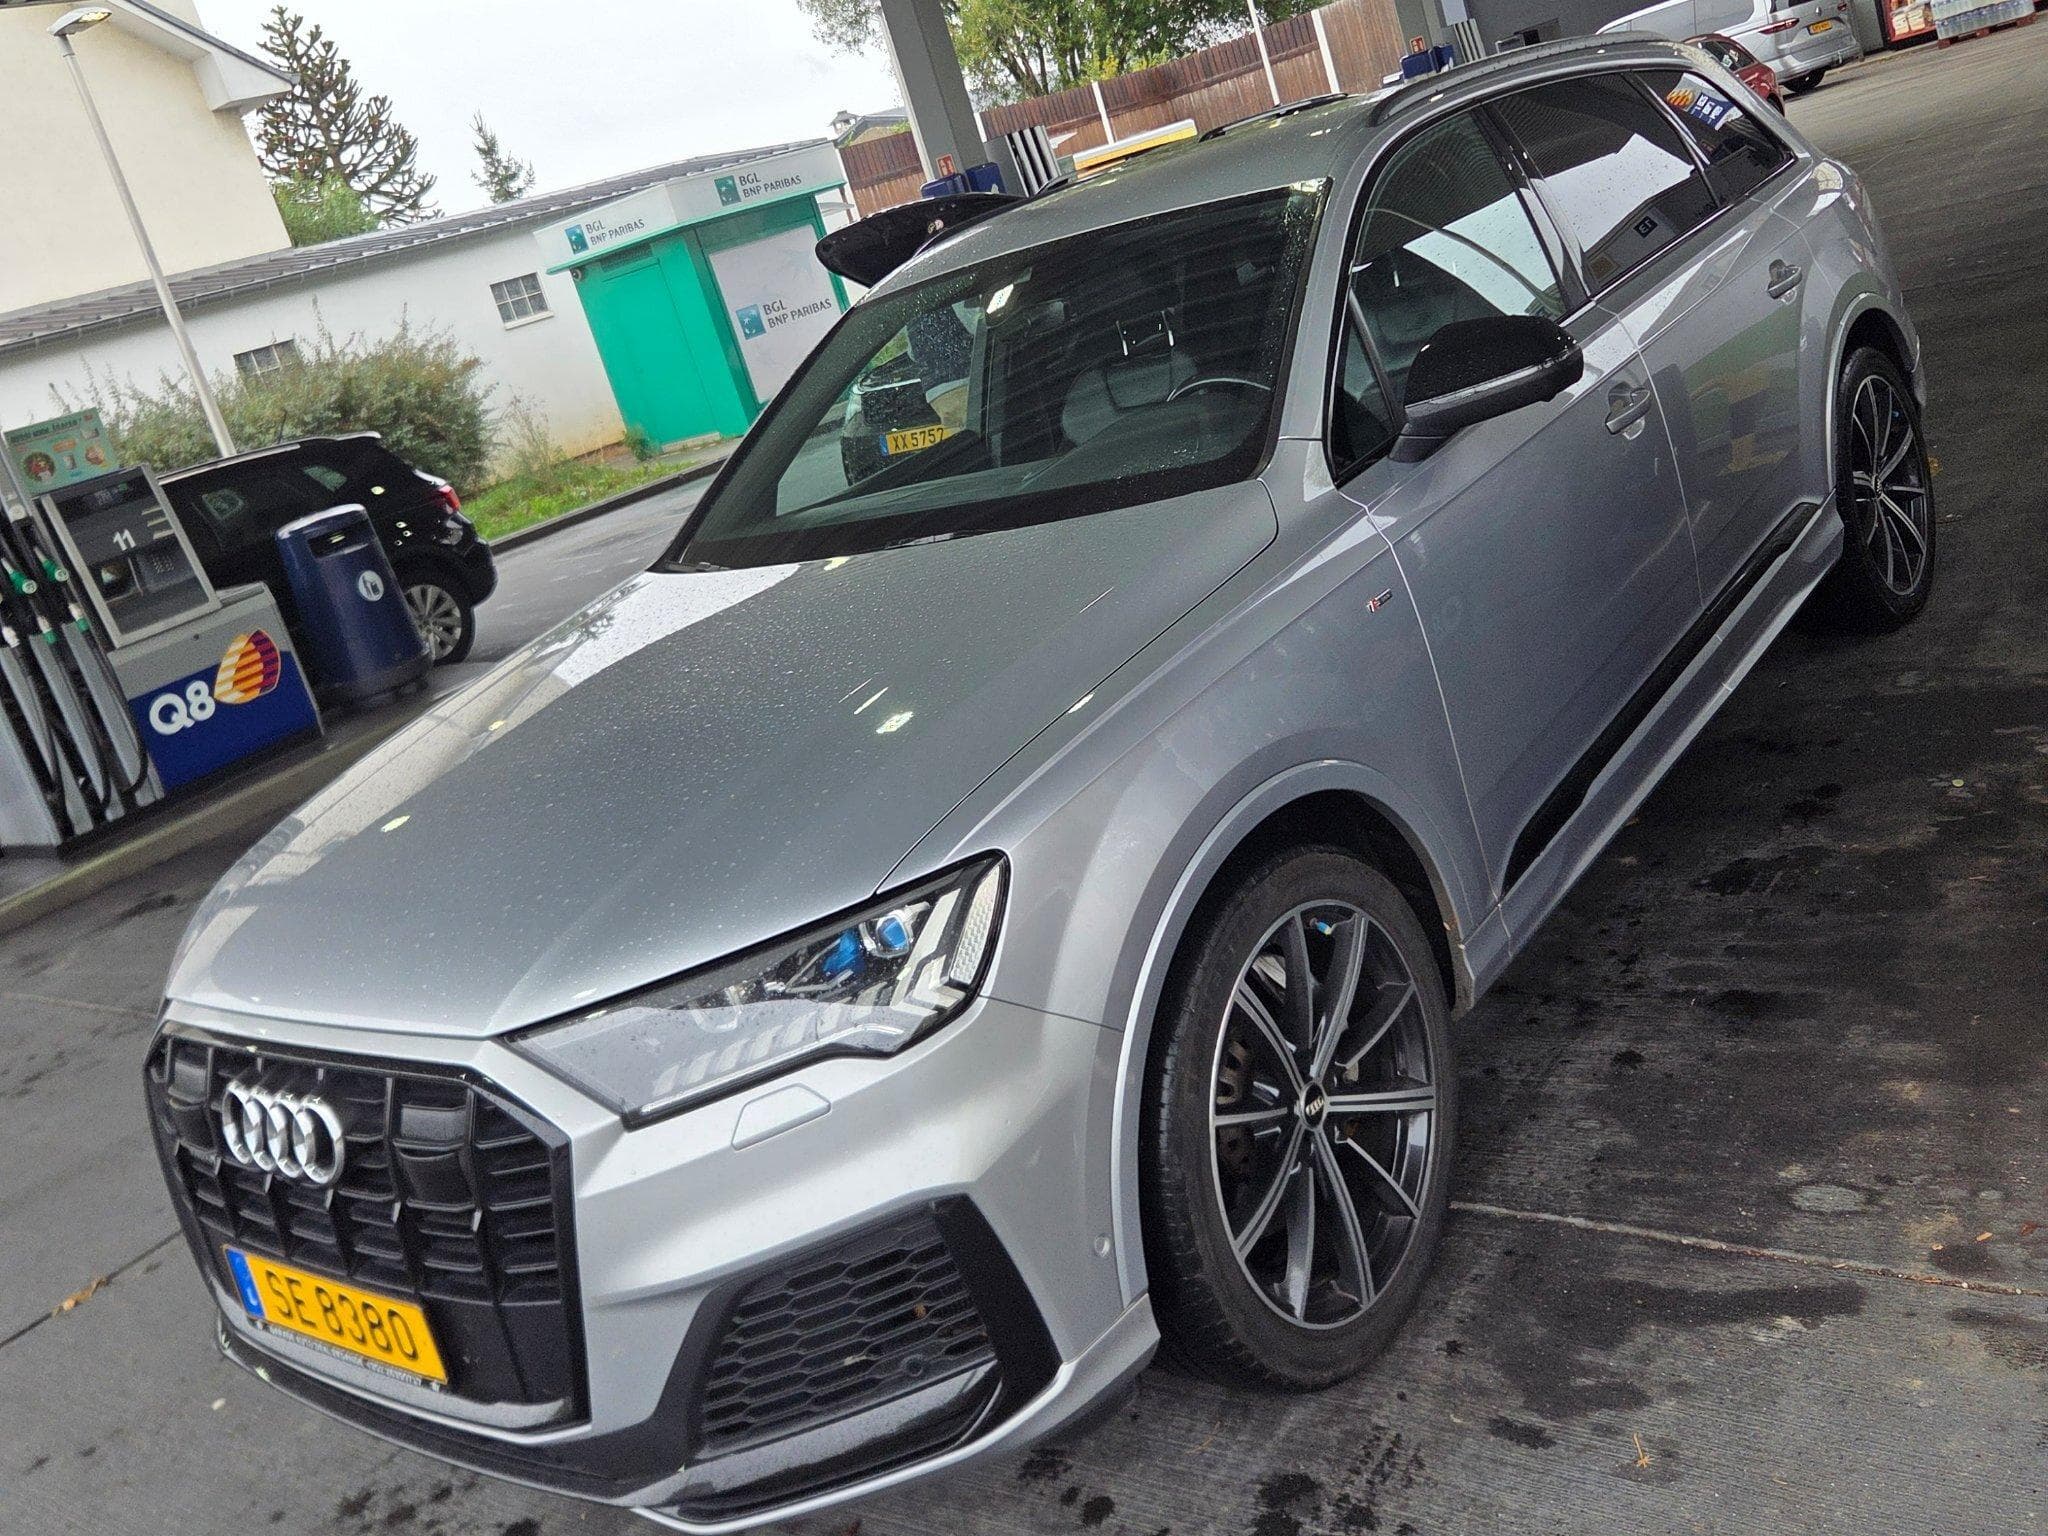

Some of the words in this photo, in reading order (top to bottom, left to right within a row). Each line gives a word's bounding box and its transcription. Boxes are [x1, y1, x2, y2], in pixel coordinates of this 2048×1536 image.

[738, 172, 762, 187] BGL
[742, 185, 763, 199] BNP
[763, 175, 802, 193] PARIBAS
[585, 219, 606, 234] BGL
[590, 232, 608, 246] BNP
[608, 218, 645, 240] PARIBAS
[762, 299, 788, 316] BGL
[767, 312, 789, 329] BNP
[789, 298, 832, 321] PARIBAS
[892, 434, 909, 452] XX
[112, 528, 137, 551] 11
[149, 680, 216, 736] Q8
[265, 1269, 318, 1330] SE
[314, 1285, 419, 1361] 8380
